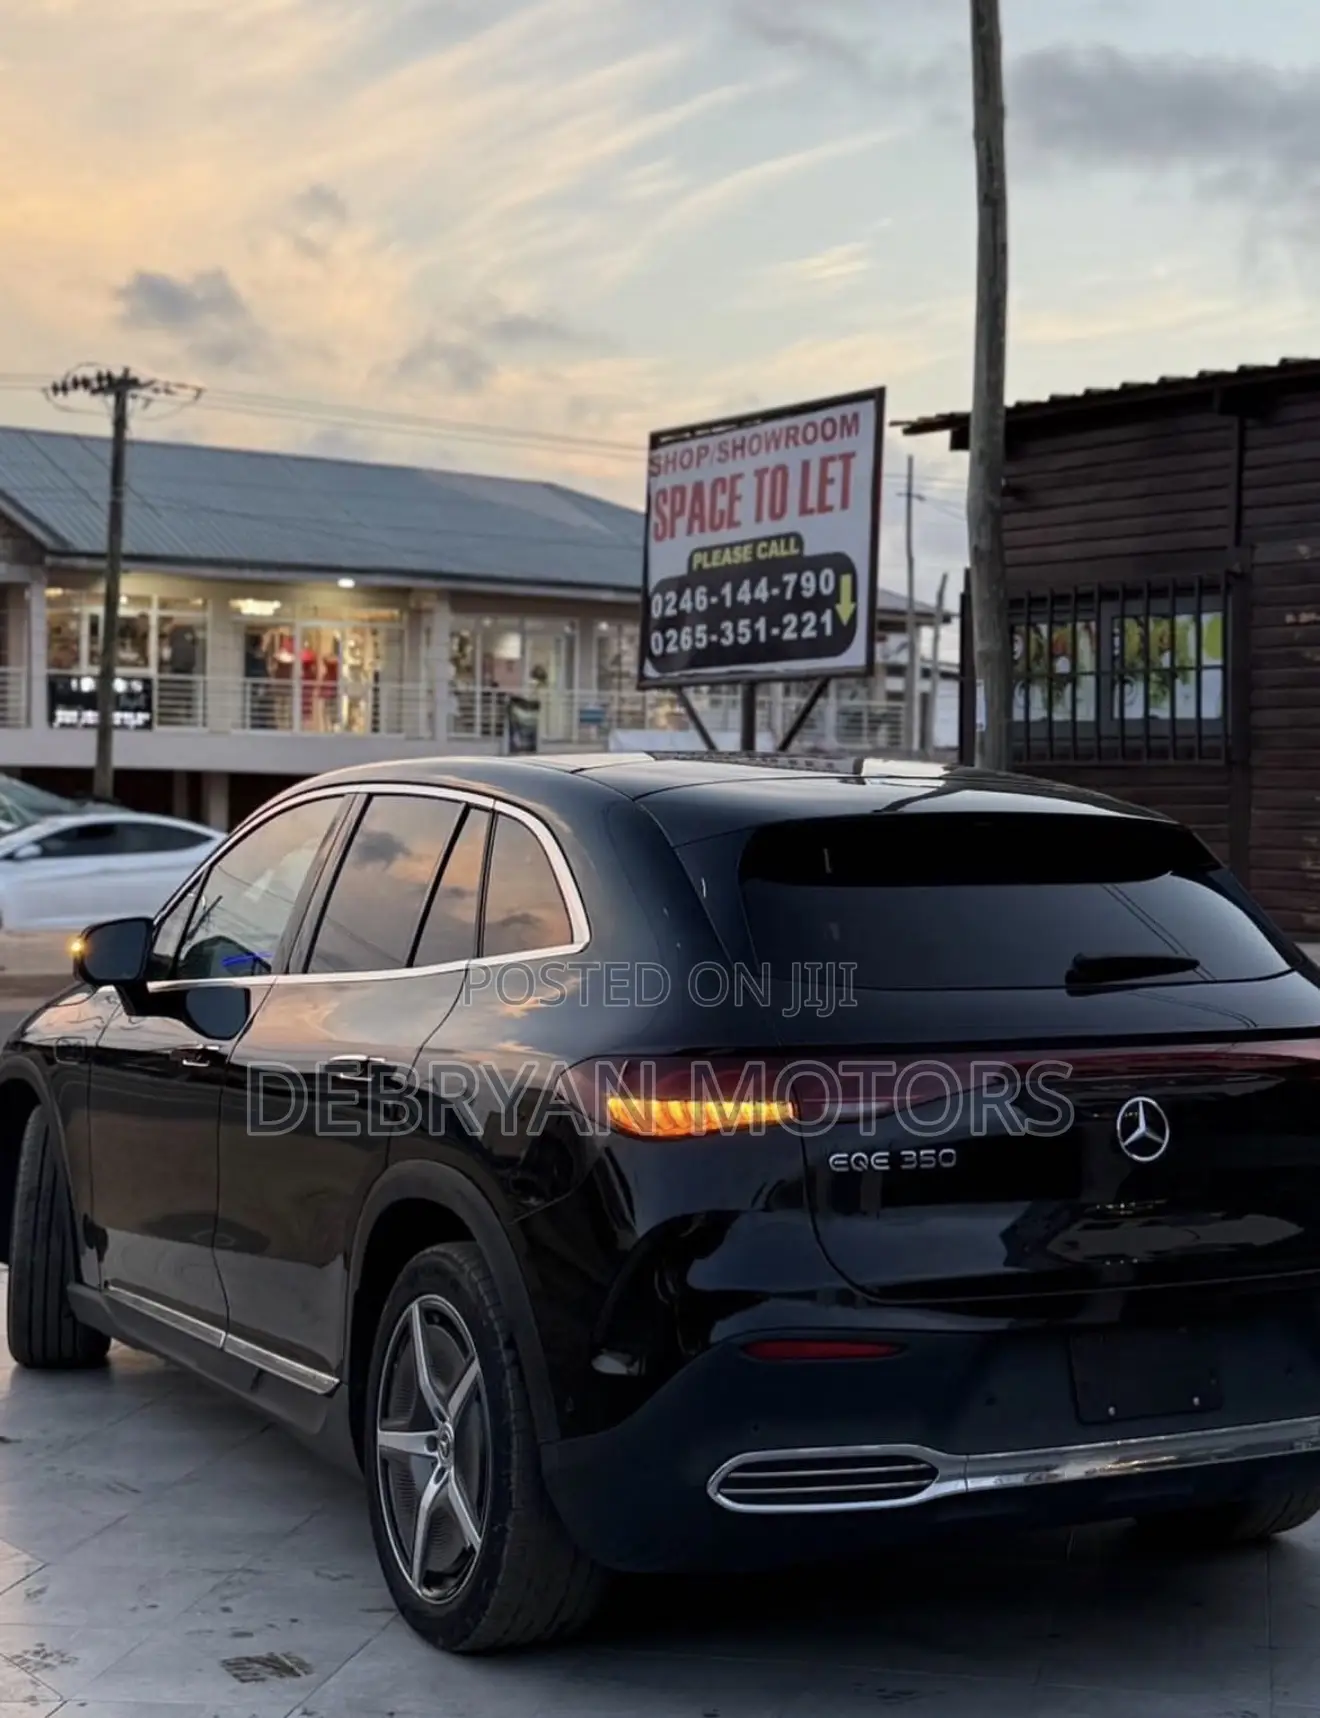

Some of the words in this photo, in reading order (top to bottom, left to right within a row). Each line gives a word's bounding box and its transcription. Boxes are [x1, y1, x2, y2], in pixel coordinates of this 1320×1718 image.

[650, 412, 861, 478] SHOP/SHOWROOM
[653, 472, 745, 542] SPACE
[753, 463, 790, 523] TO
[797, 451, 857, 519] LET
[691, 542, 755, 571] PLEASE
[756, 537, 800, 560] CALL
[651, 568, 836, 619] 0246-144-790
[651, 608, 834, 657] 0265-351-221
[827, 1151, 891, 1173] EQE
[899, 1147, 958, 1171] 350
